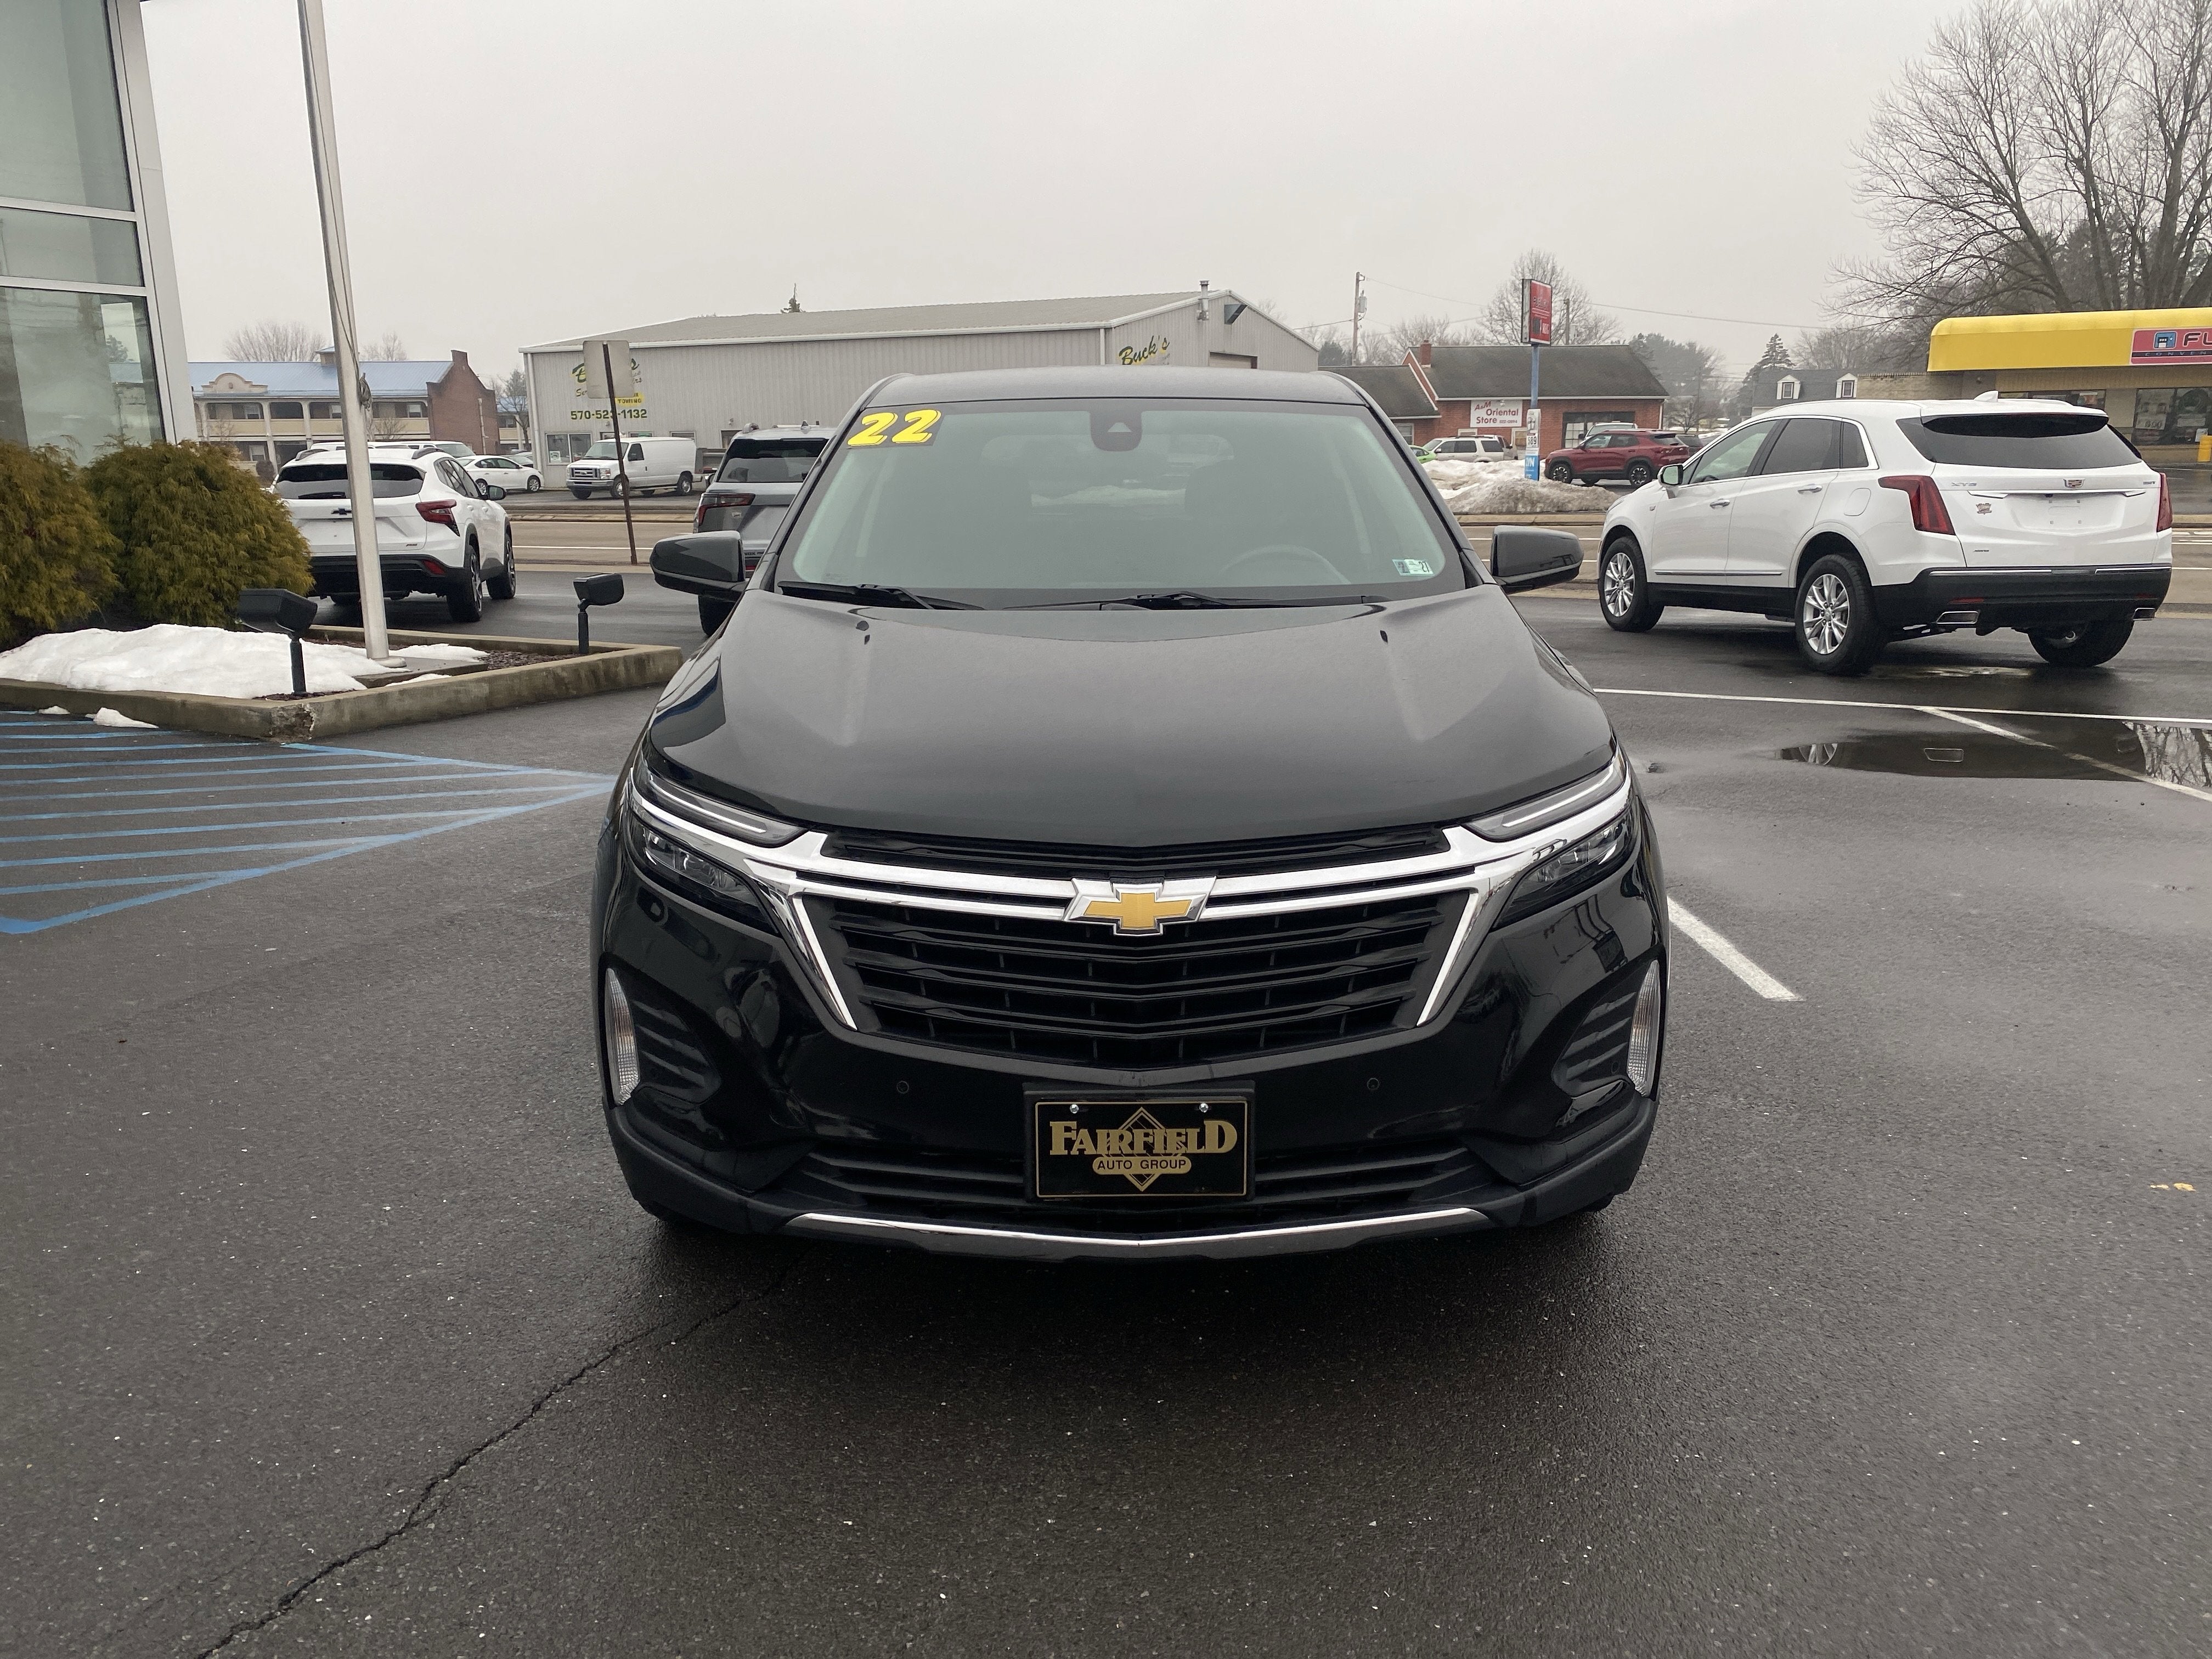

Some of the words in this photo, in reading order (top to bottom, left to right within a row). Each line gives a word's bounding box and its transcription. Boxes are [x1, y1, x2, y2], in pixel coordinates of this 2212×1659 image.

[1119, 335, 1170, 365] Buck's
[847, 409, 941, 447] 22
[1049, 1120, 1238, 1155] FAIRFIELD
[1097, 1159, 1132, 1170] AUTO
[1140, 1159, 1186, 1170] GROUP
